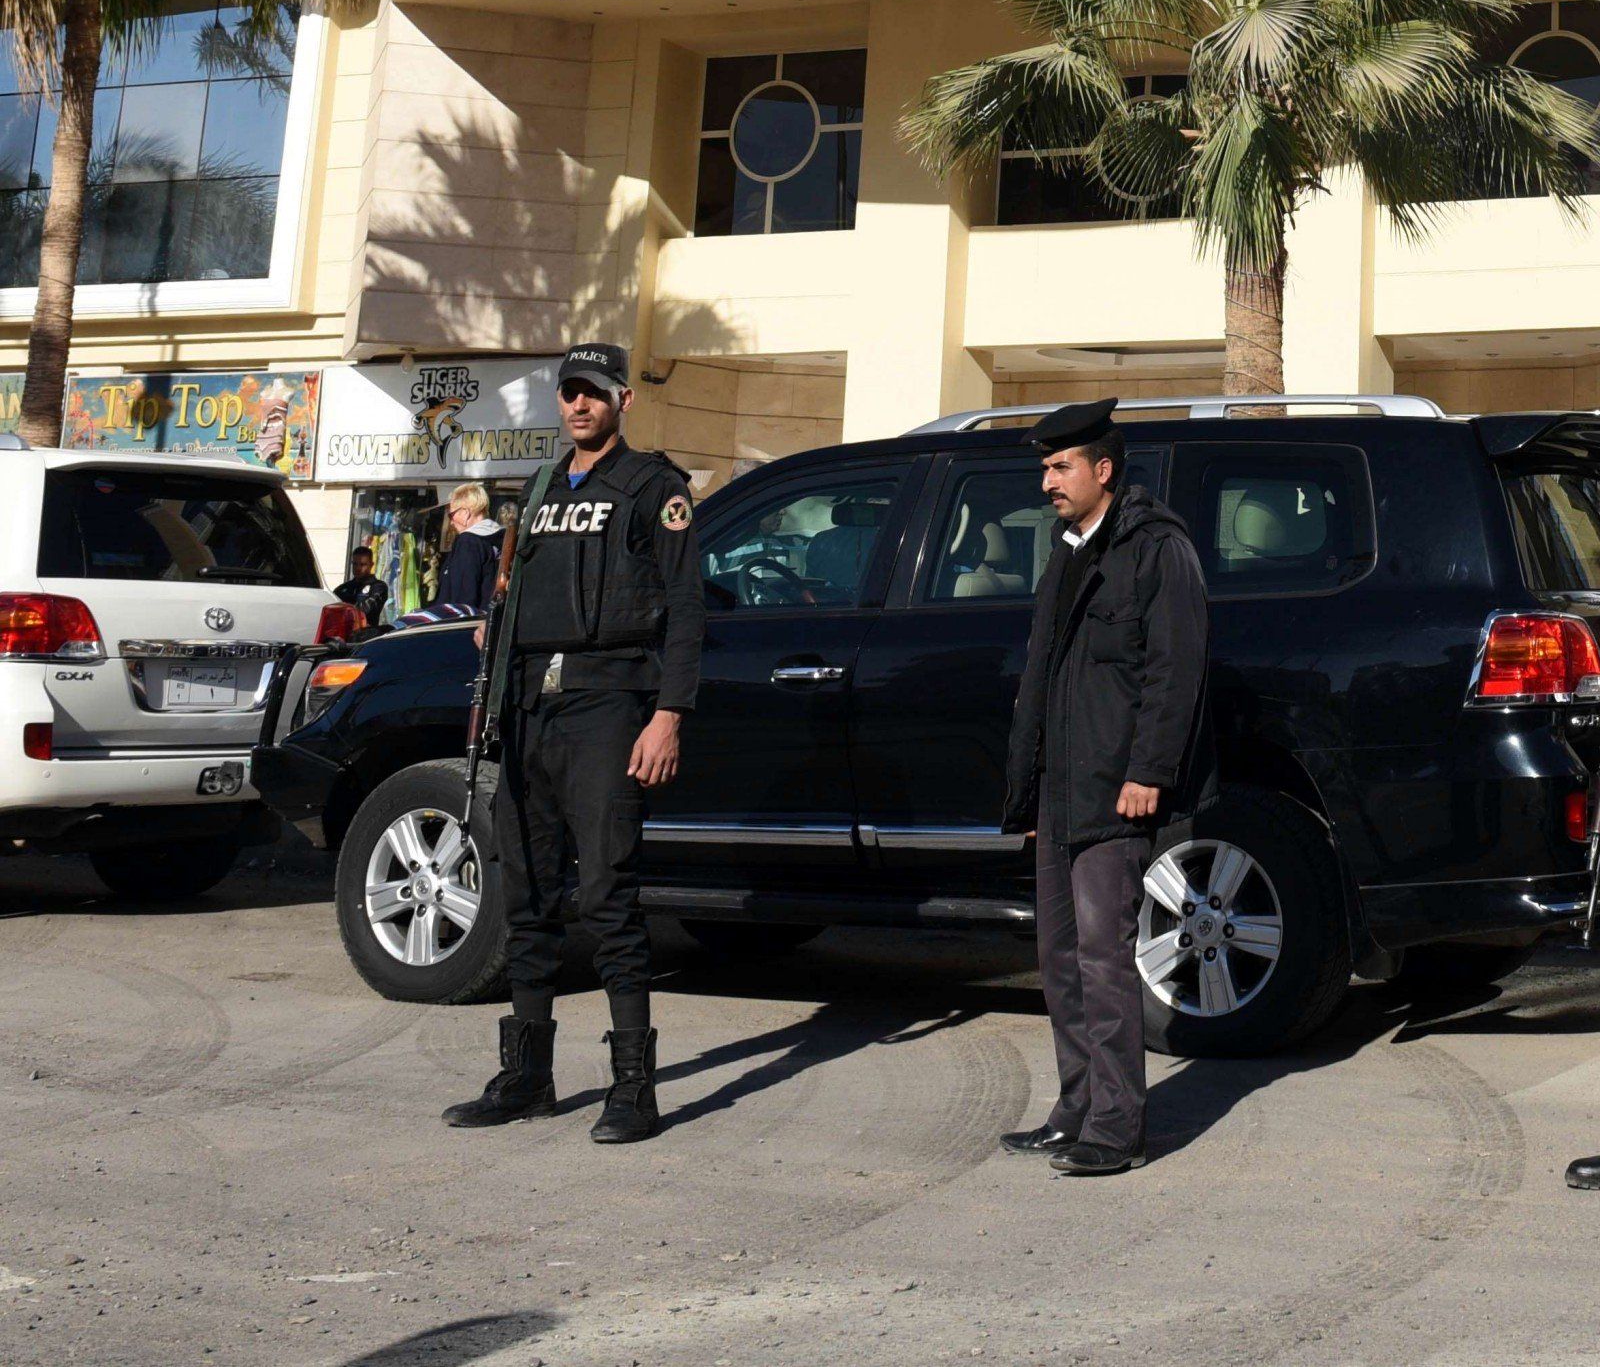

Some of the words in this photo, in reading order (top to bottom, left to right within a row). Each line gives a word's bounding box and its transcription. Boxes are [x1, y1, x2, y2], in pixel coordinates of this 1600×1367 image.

[568, 351, 608, 366] POLICE
[420, 367, 469, 384] TIGER
[411, 381, 479, 403] SHARKS
[99, 383, 160, 441] Tip
[171, 383, 244, 441] Top
[328, 433, 431, 465] SOUVENIRS
[460, 427, 560, 462] MARKET
[523, 502, 613, 534] OLICE
